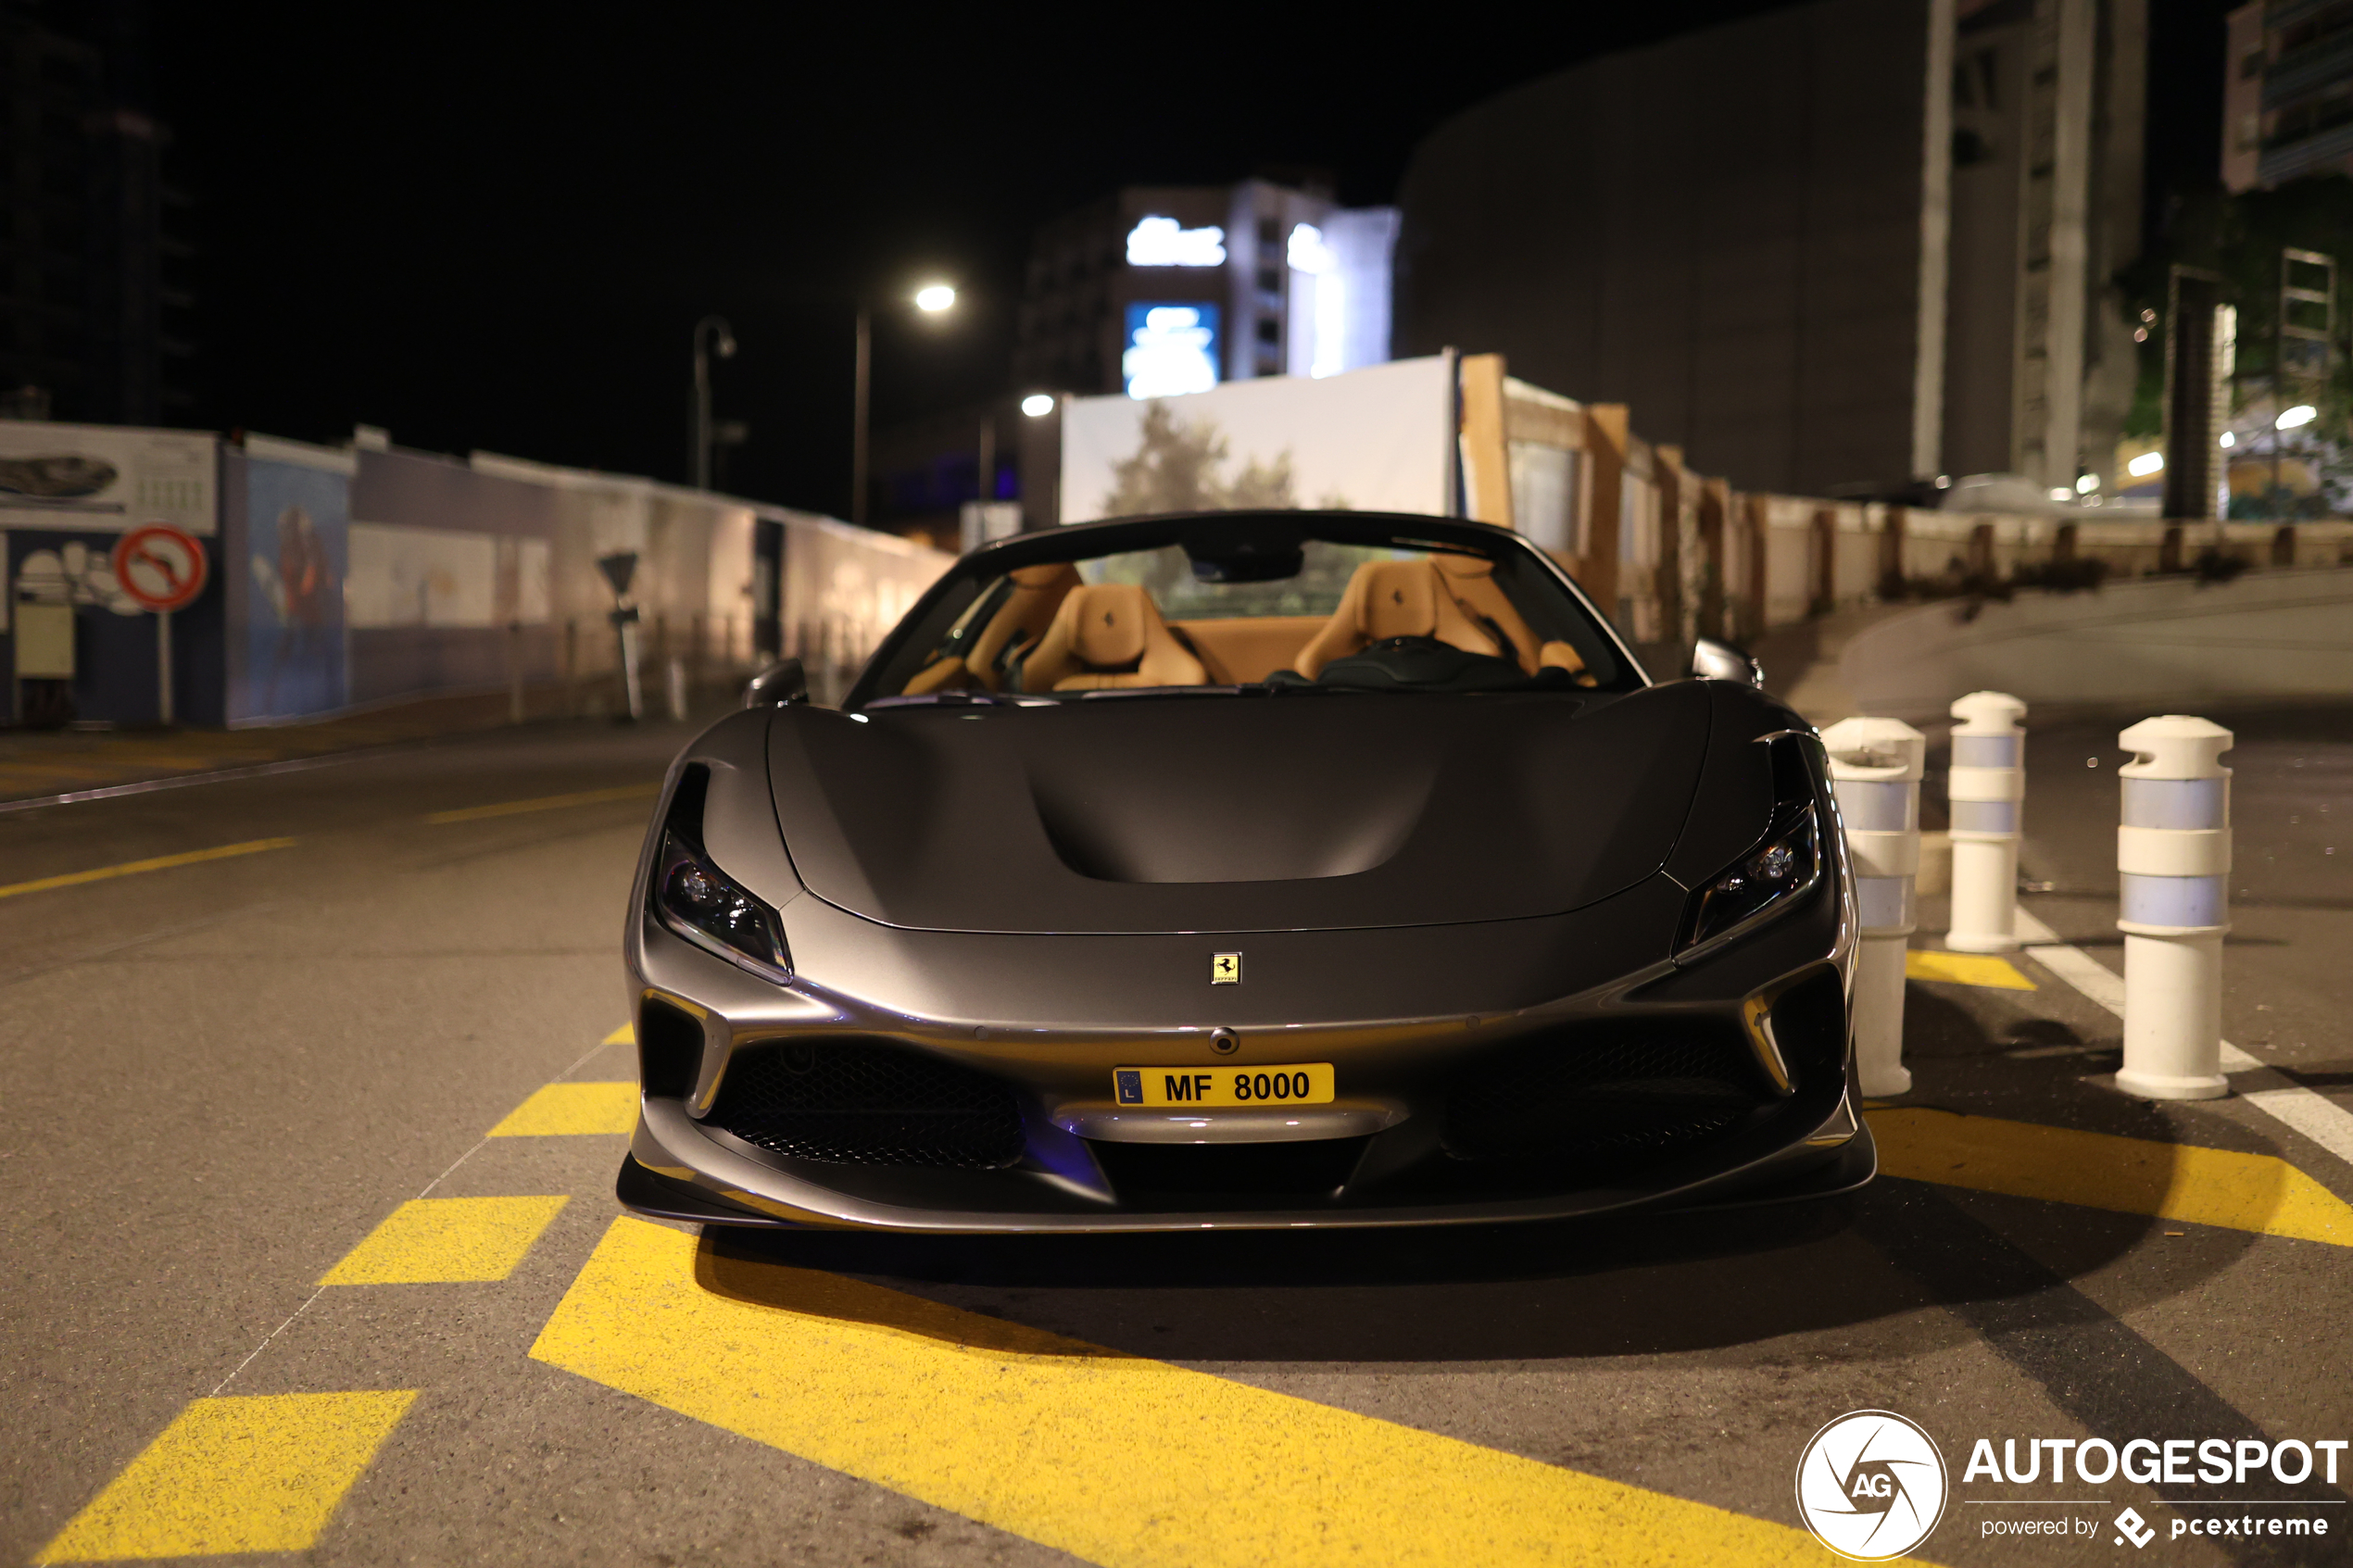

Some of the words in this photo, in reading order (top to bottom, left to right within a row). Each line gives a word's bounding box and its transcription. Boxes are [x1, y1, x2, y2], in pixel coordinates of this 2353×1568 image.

[1125, 1088, 1135, 1098] L
[1164, 1074, 1213, 1101] MF
[1234, 1072, 1310, 1101] 8000
